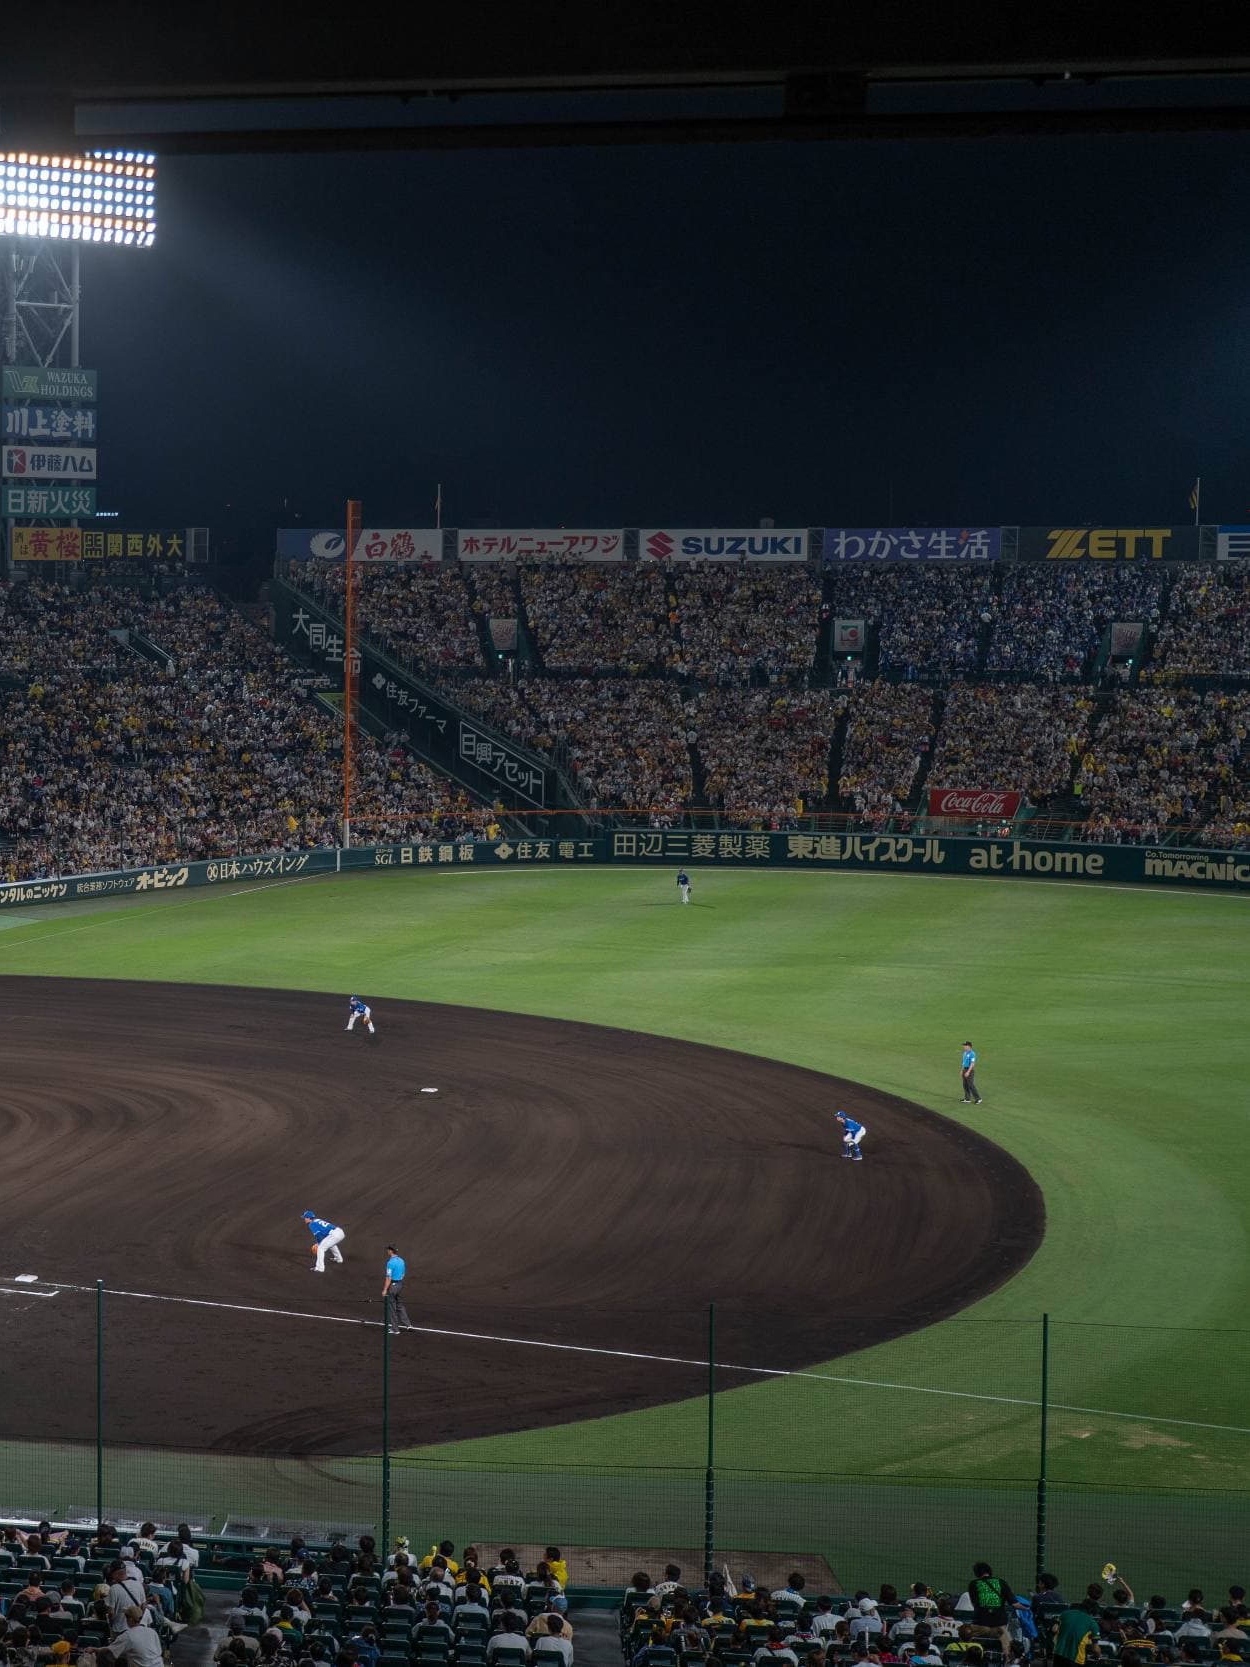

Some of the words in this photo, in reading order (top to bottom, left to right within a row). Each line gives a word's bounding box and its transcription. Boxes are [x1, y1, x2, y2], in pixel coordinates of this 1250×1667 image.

[40, 384, 94, 398] HOLDINGS
[6, 407, 95, 438] 川上塗料
[29, 454, 94, 473] 伊藤ハム
[7, 489, 92, 514] 日新火災
[108, 533, 184, 558] 関西外大
[461, 535, 621, 557] ホテルニューアワジ
[681, 536, 802, 556] SUZUKI
[833, 530, 992, 560] わかさ生活
[1045, 529, 1172, 560] ZETT
[386, 682, 447, 734] 住友ファーマ
[461, 734, 542, 795] 日興アセット
[400, 844, 474, 864] 日鉄鋼板
[516, 841, 594, 860] 住友電工
[613, 833, 771, 859] 田辺三菱製薬
[786, 835, 945, 864] 東進ハイスクール
[135, 867, 189, 890] オービック
[220, 854, 310, 880] 日本ハウズイング
